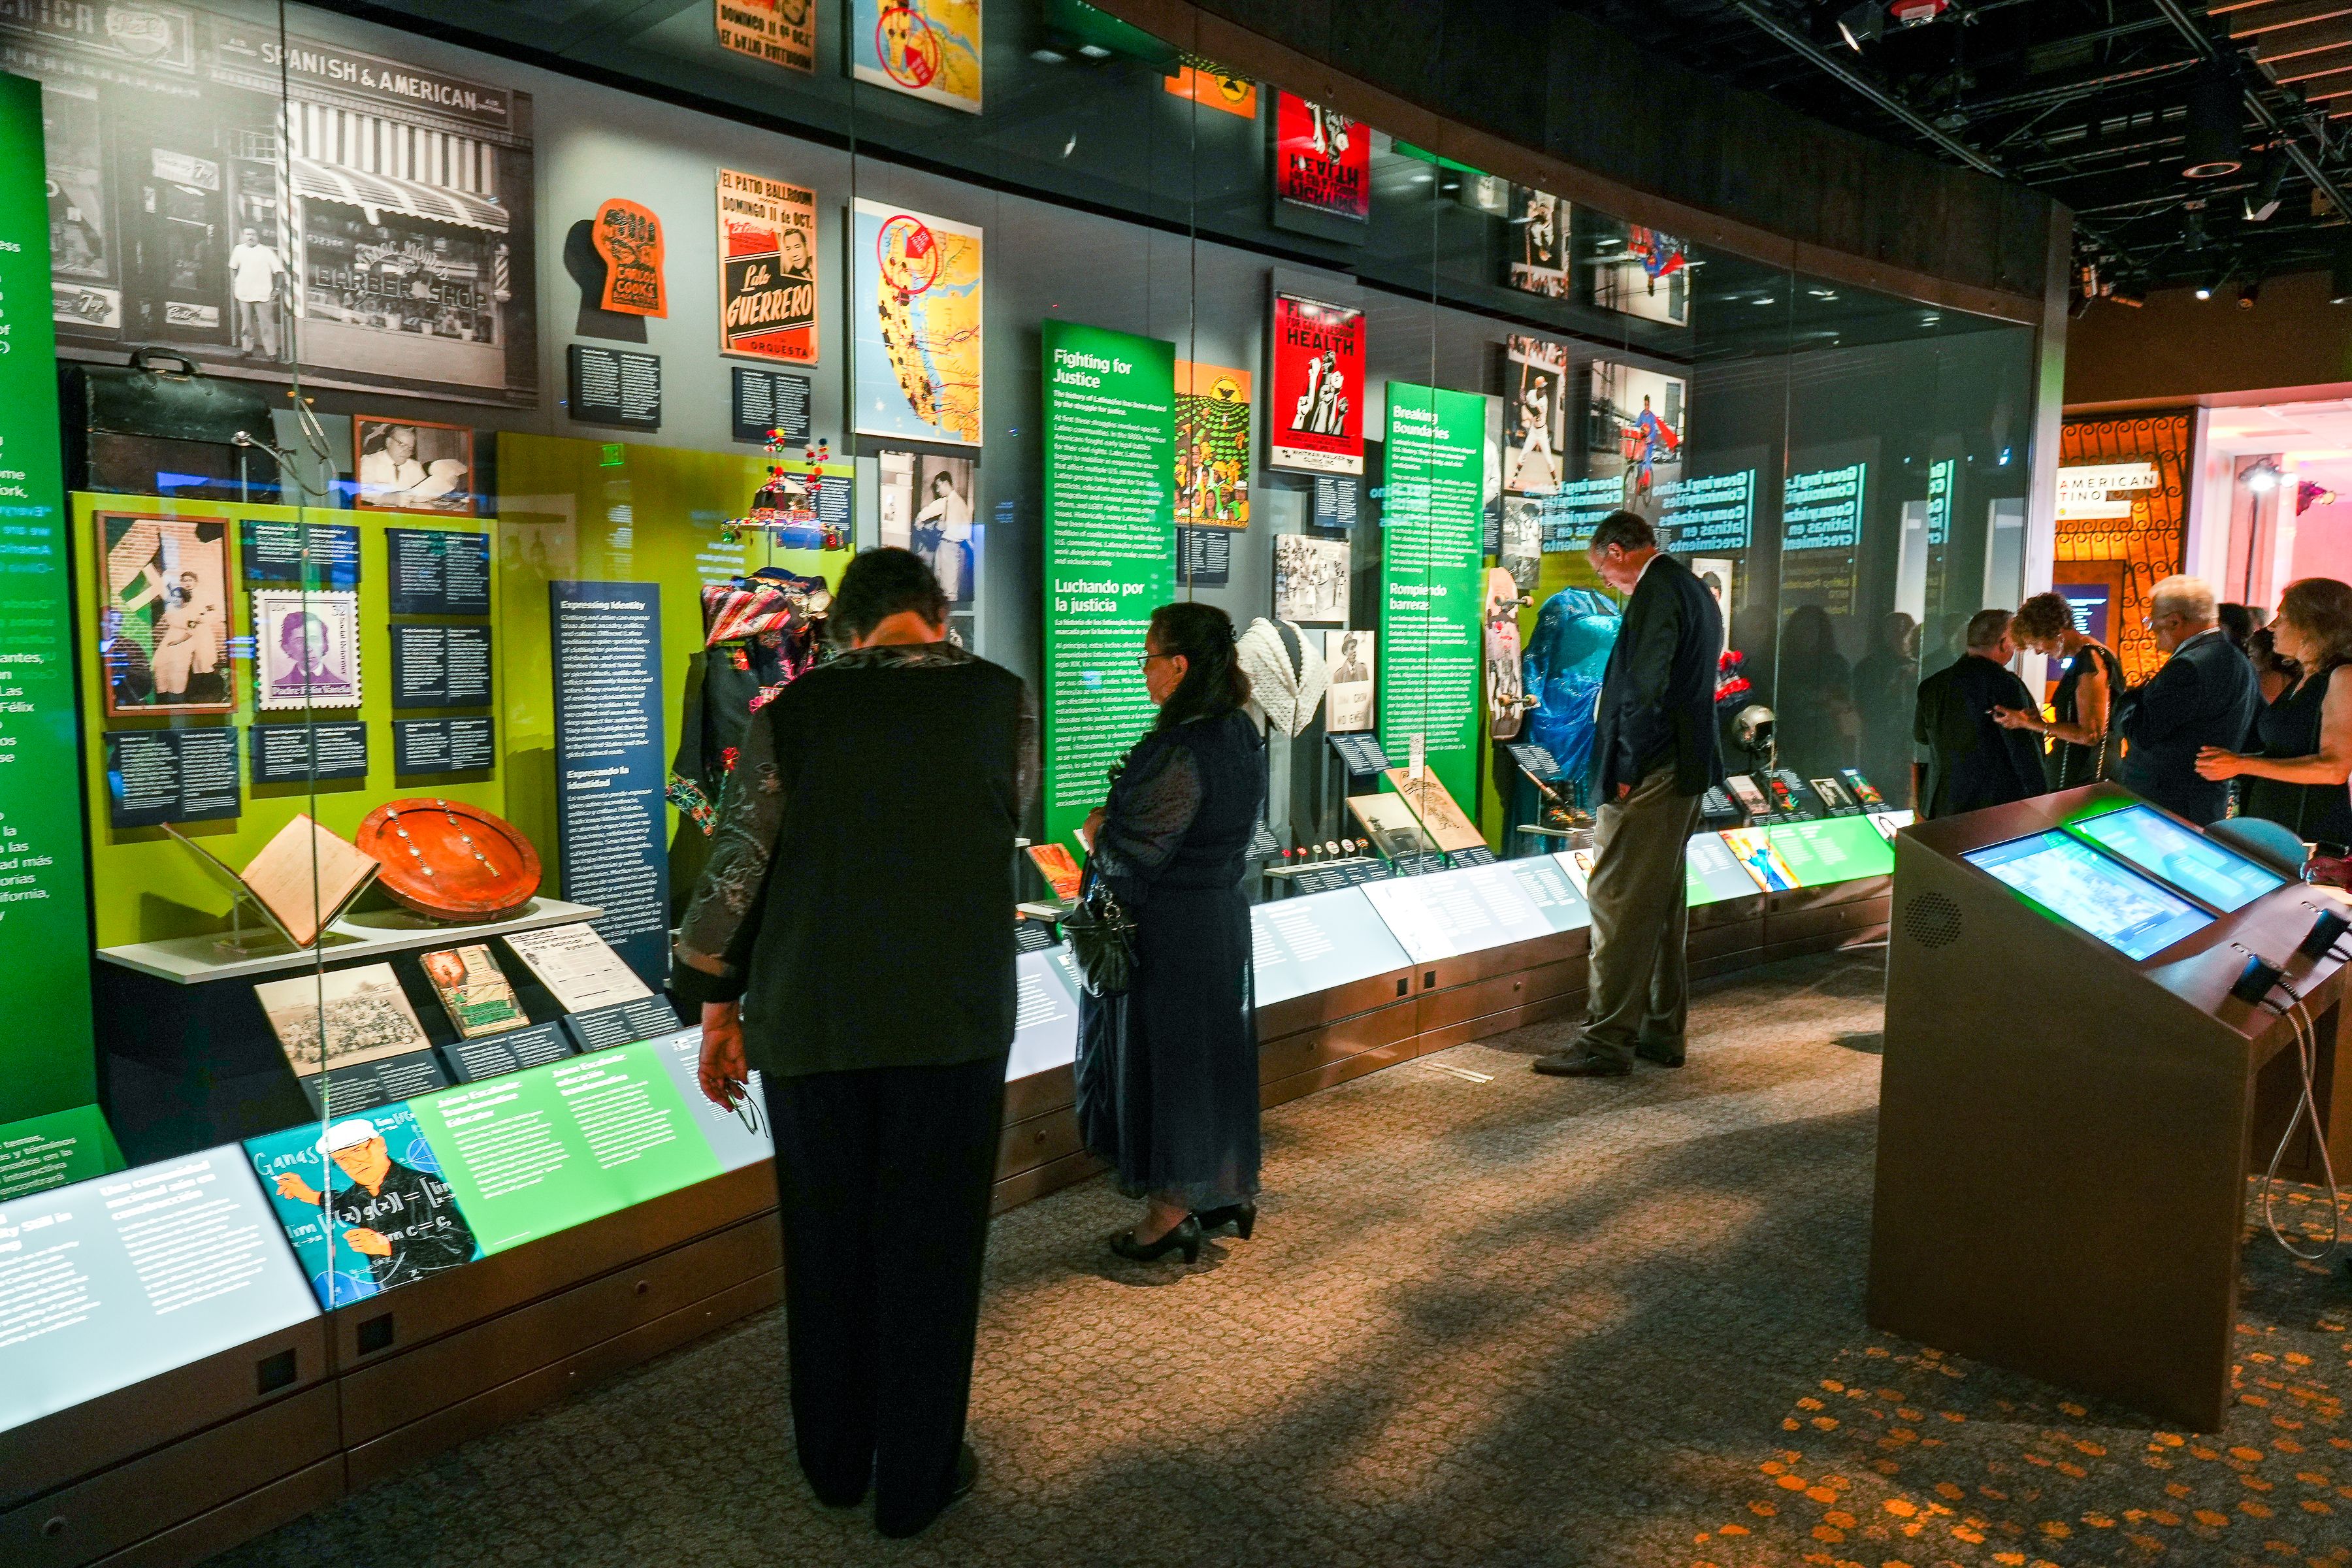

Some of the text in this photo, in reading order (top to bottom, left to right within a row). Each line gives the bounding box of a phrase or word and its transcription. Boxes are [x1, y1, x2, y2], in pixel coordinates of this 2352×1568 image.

[262, 42, 477, 112] SPANISH & AMERICAN
[723, 172, 813, 207] EL PATIO BALLROOM
[723, 196, 765, 218] DOMINGO
[741, 264, 772, 292] Lalo
[727, 284, 813, 329] GUERRERO
[751, 340, 809, 359] ORQUESTA
[1287, 328, 1354, 357] HEALTH
[1053, 348, 1132, 375] Fighting for
[1053, 368, 1101, 389] Justice
[1393, 405, 1438, 425] Breaking
[2060, 476, 2154, 489] AMERICAN
[2060, 491, 2100, 501] TINO
[1054, 578, 1145, 596] Luchando por
[1390, 583, 1447, 598] Rompiendo
[559, 601, 645, 610] Expressing Identity
[1055, 597, 1117, 614] la justicia
[566, 767, 619, 778] Expresando
[567, 778, 610, 790] identidad
[22, 855, 53, 868] más
[253, 1146, 320, 1177] Ganas
